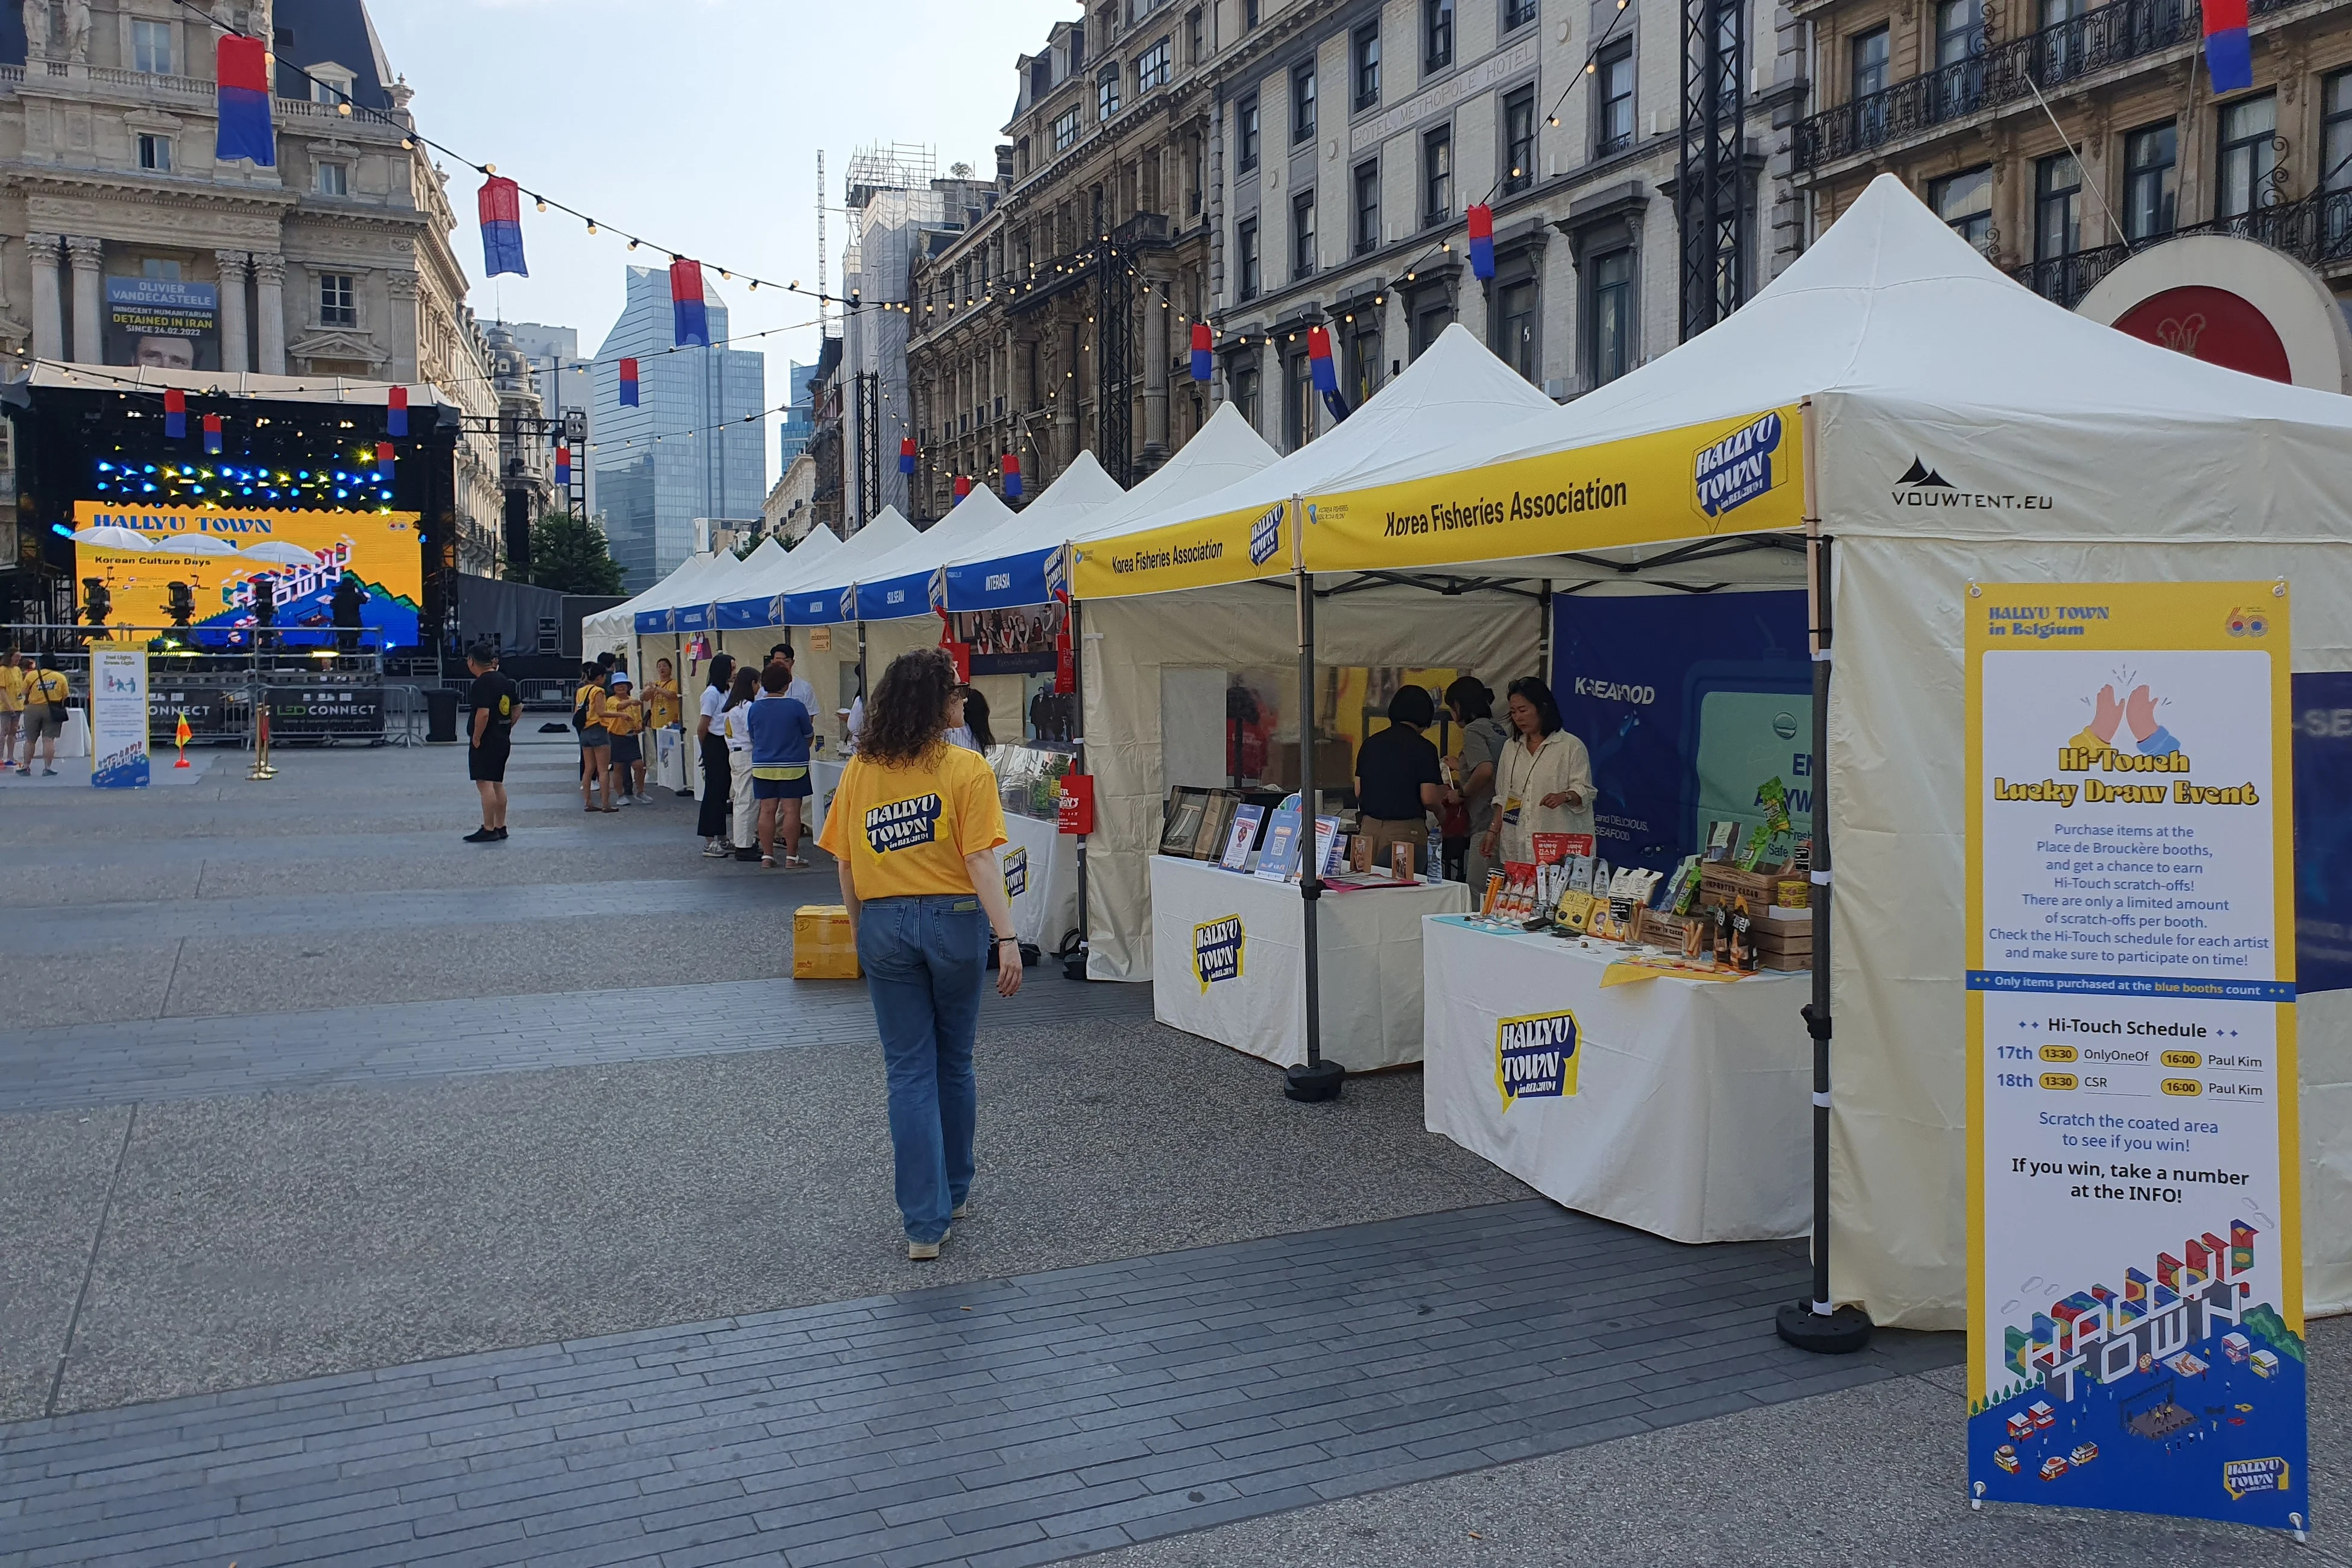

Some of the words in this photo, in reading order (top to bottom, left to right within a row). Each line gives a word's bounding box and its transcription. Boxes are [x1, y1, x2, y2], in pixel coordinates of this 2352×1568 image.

[1486, 45, 1534, 81] HOTEL
[112, 289, 211, 306] VANDECASTEELE
[139, 282, 186, 294] OLIVIER
[113, 305, 153, 314] INNOCENT
[154, 308, 212, 318] HUMANITARIAN
[113, 314, 169, 326] DETAINED
[172, 317, 183, 326] IN
[186, 319, 212, 329] IRAN
[125, 324, 153, 333] SINCE
[1696, 413, 1775, 478] HALLYU
[1697, 450, 1764, 507] TOWN
[1383, 511, 1429, 537] Korea
[1431, 496, 1505, 531] Fisheries
[1509, 478, 1628, 522] Association
[1891, 492, 2053, 510] VOUWTENT.EU
[93, 514, 185, 531] HALLYU
[195, 517, 272, 533] TOWN
[1251, 503, 1282, 542] HALLYU
[1250, 526, 1276, 560] TOWN
[95, 555, 136, 564] Korean
[139, 557, 180, 566] Culture
[183, 558, 211, 566] Days
[1112, 555, 1134, 574] Korea
[1135, 545, 1171, 572] Fisheries
[1172, 539, 1224, 565] Association
[985, 572, 1011, 591] INTERASIA
[1989, 606, 2050, 620] HALLYU
[2055, 606, 2109, 620] TOWN
[1989, 622, 2006, 635] in
[2012, 622, 2084, 639] Belgium
[149, 705, 210, 716] ONNECT
[277, 705, 306, 716] LED
[308, 704, 376, 716] CONNECT
[2058, 747, 2190, 773] Hi-Touch
[1994, 777, 2079, 808] Lucky
[2084, 779, 2167, 803] Draw
[2173, 780, 2260, 806] Event
[867, 794, 935, 828] HALLYU
[1503, 812, 1519, 821] STAFF
[1595, 814, 1610, 823] and
[868, 817, 928, 846] TOWN
[1595, 826, 1630, 841] SEAFOOD
[2055, 823, 2113, 836] Purchase
[2117, 824, 2152, 837] items
[2156, 827, 2168, 837] at
[2172, 826, 2194, 838] the
[1768, 843, 1789, 858] Safe
[2037, 841, 2070, 853] Place
[2074, 841, 2090, 853] de
[2093, 842, 2159, 855] Brouckère
[2163, 844, 2213, 859] booths,
[1005, 849, 1025, 874] HALLYU
[2046, 859, 2070, 871] and
[2073, 861, 2093, 874] get
[2096, 863, 2104, 872] a
[2107, 861, 2153, 873] chance
[2157, 863, 2170, 873] to
[2173, 864, 2203, 874] earn
[1006, 868, 1023, 890] TOWN
[2054, 877, 2110, 890] Hi-Touch
[2113, 878, 2195, 892] scratch-offs!
[2022, 894, 2058, 905] There
[2062, 897, 2082, 906] are
[2085, 896, 2113, 909] only
[2116, 899, 2123, 908] a
[2126, 896, 2173, 909] limited
[2176, 899, 2229, 911] amount
[2045, 912, 2058, 924] of
[2061, 913, 2136, 926] scratch-offs
[2139, 917, 2161, 929] per
[2164, 916, 2207, 928] booth.
[1197, 918, 1238, 949] HALLYU
[1989, 928, 2028, 940] Check
[2031, 929, 2051, 941] the
[2055, 930, 2111, 944] Hi-Touch
[2114, 931, 2173, 946] schedule
[2176, 934, 2195, 946] for
[2198, 934, 2230, 947] each
[2233, 937, 2269, 949] artist
[1197, 944, 1234, 972] TOWN
[2005, 947, 2029, 958] and
[2032, 948, 2068, 959] make
[2070, 952, 2098, 961] sure
[2101, 951, 2114, 961] to
[2118, 952, 2189, 966] participate
[2192, 955, 2208, 964] on
[2211, 953, 2248, 966] time!
[1994, 976, 2020, 988] Only
[2023, 976, 2054, 988] items
[2057, 978, 2114, 990] purchased
[2117, 981, 2129, 990] at
[2132, 981, 2152, 991] the
[2155, 982, 2180, 992] blue
[2183, 983, 2223, 994] booths
[2226, 985, 2261, 995] count
[1501, 1016, 1569, 1051] HALLYU
[2049, 1017, 2122, 1034] Hi-Touch
[2127, 1020, 2207, 1037] Schedule
[1997, 1045, 2033, 1060] 17th
[2044, 1049, 2072, 1059] 13:30
[2084, 1049, 2149, 1063] OnlyOneOf
[2166, 1054, 2195, 1065] 16:00
[2208, 1054, 2235, 1067] Paul
[2238, 1055, 2262, 1067] Kim
[1502, 1051, 1560, 1082] TOWN
[1997, 1073, 2033, 1087] 18th
[2044, 1076, 2072, 1086] 13:30
[2084, 1076, 2107, 1087] CSR
[2166, 1082, 2195, 1093] 16:00
[2208, 1083, 2235, 1095] Paul
[2238, 1084, 2263, 1096] Kim
[2039, 1111, 2095, 1127] Scratch
[2099, 1114, 2124, 1128] the
[2128, 1117, 2180, 1131] coated
[2184, 1120, 2218, 1134] area
[2063, 1133, 2078, 1146] to
[2081, 1137, 2107, 1148] see
[2111, 1134, 2121, 1148] if
[2123, 1139, 2152, 1152] you
[2156, 1139, 2190, 1152] win!
[2012, 1158, 2026, 1172] If
[2029, 1162, 2063, 1177] you
[2067, 1160, 2105, 1179] win,
[2111, 1163, 2151, 1179] take
[2157, 1168, 2167, 1180] a
[2173, 1169, 2249, 1185] number
[2070, 1184, 2089, 1198] at
[2093, 1184, 2124, 1200] the
[2129, 1186, 2182, 1203] INFO!
[2020, 1227, 2259, 1380] HALLYU
[2052, 1283, 2241, 1403] TOWN
[2228, 1459, 2280, 1475] HALLYU
[2229, 1473, 2274, 1488] TOWN
